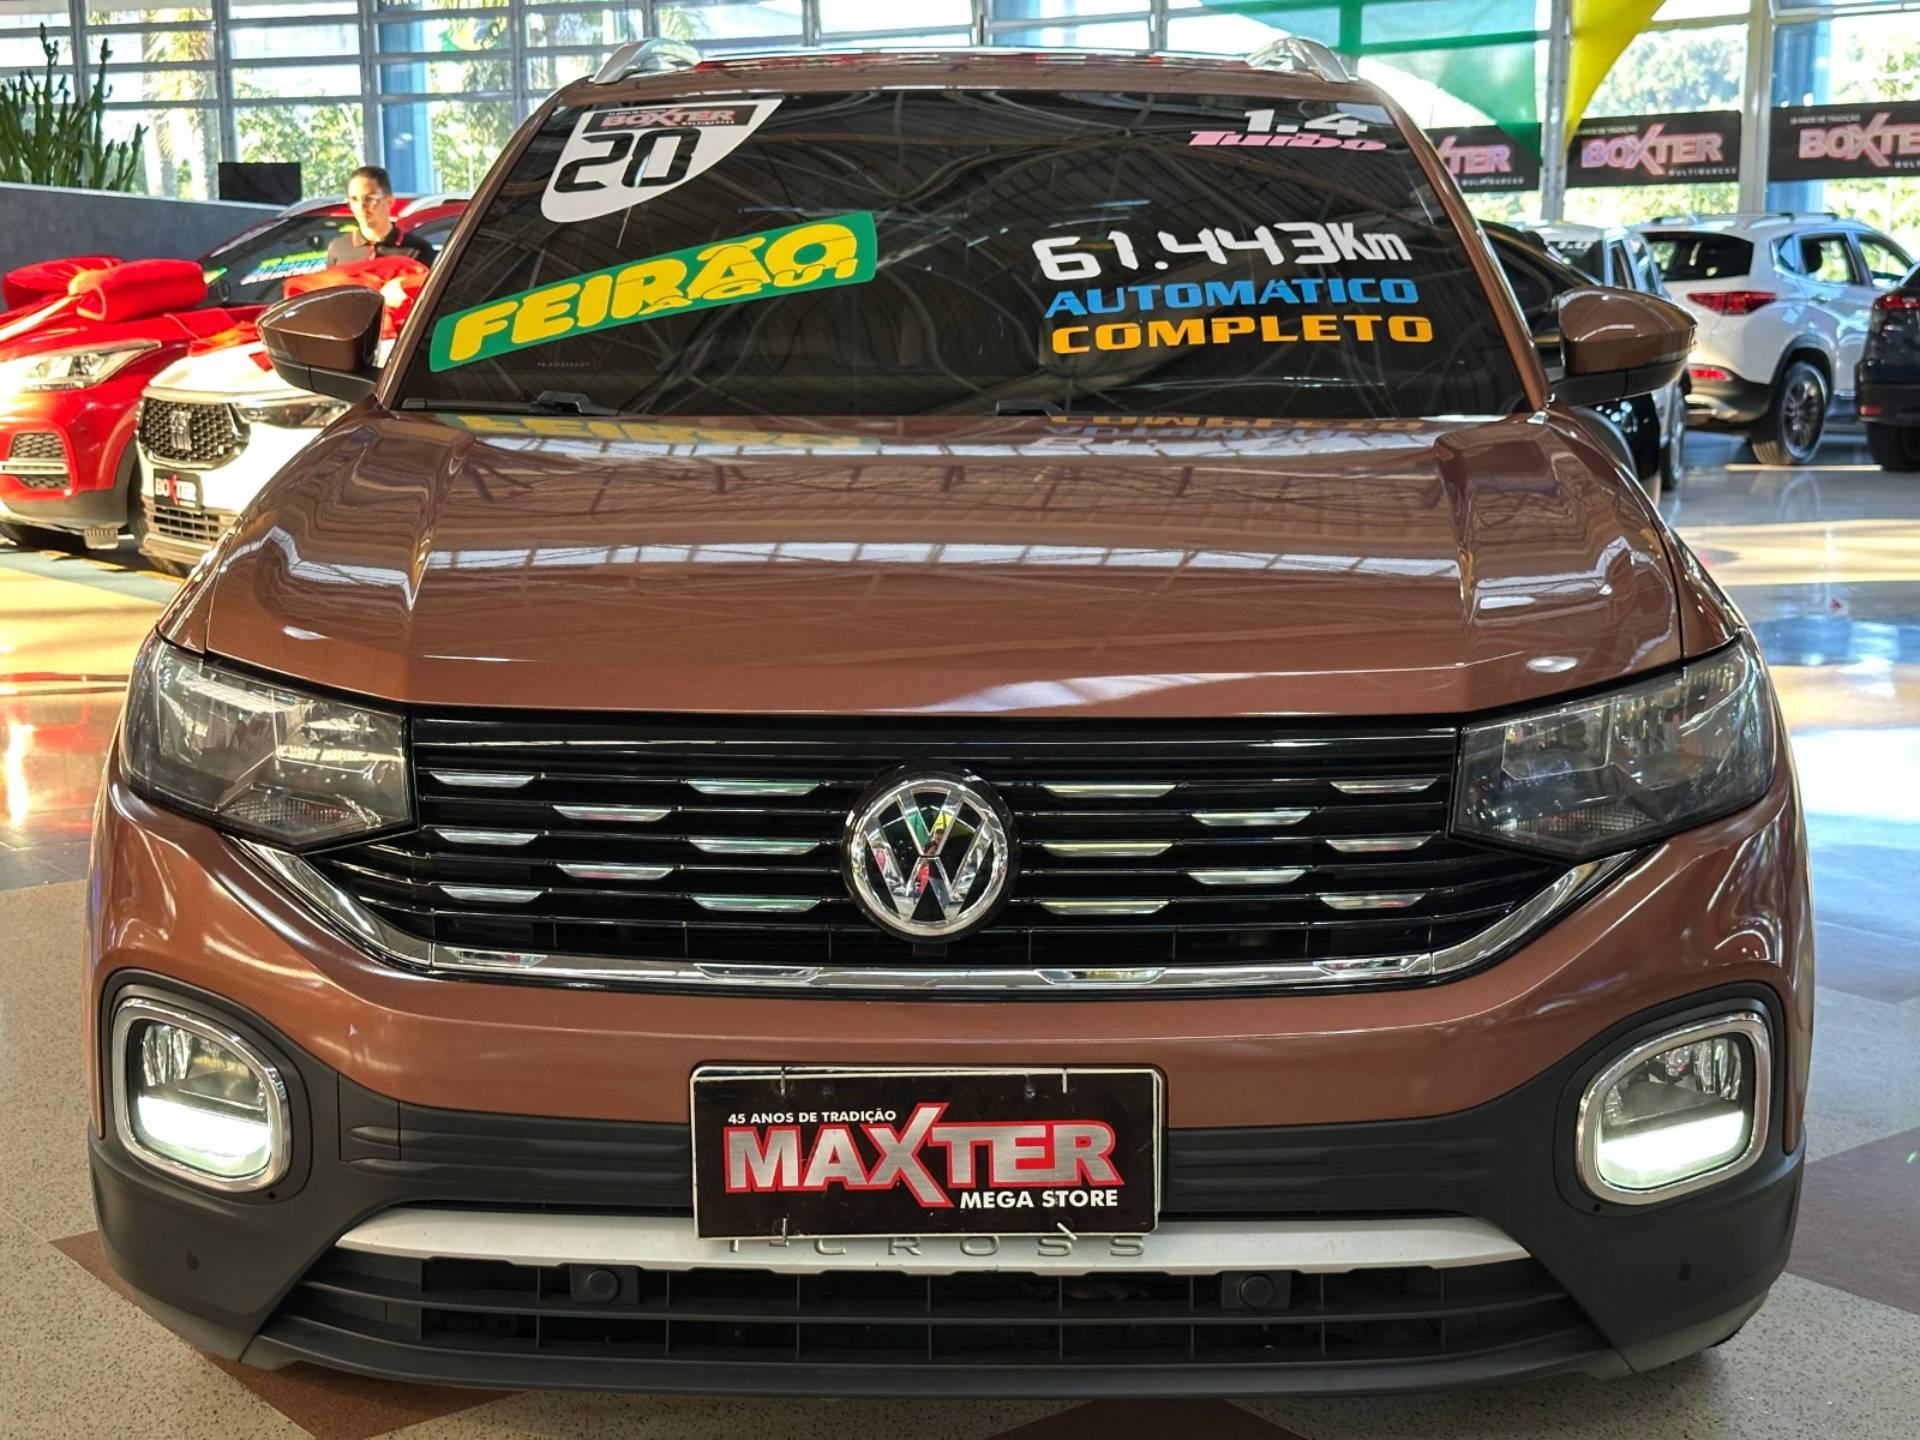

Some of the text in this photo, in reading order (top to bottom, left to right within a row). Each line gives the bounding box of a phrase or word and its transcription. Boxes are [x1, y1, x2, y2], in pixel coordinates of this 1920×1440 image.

[600, 107, 736, 127] BOXTER
[1244, 109, 1369, 136] 1.4
[1188, 130, 1387, 151] Turbo
[1581, 122, 1725, 176] BOXTER
[1798, 111, 1920, 168] BOXTE
[553, 127, 702, 193] 20
[449, 223, 858, 361] FEIRÃO
[1052, 315, 1433, 354] COMPLETO
[728, 1108, 897, 1124] 45 ANOS DE TRADIÇÃO
[723, 1102, 1126, 1208] MAXTER
[959, 1189, 1118, 1209] MEGA STORE
